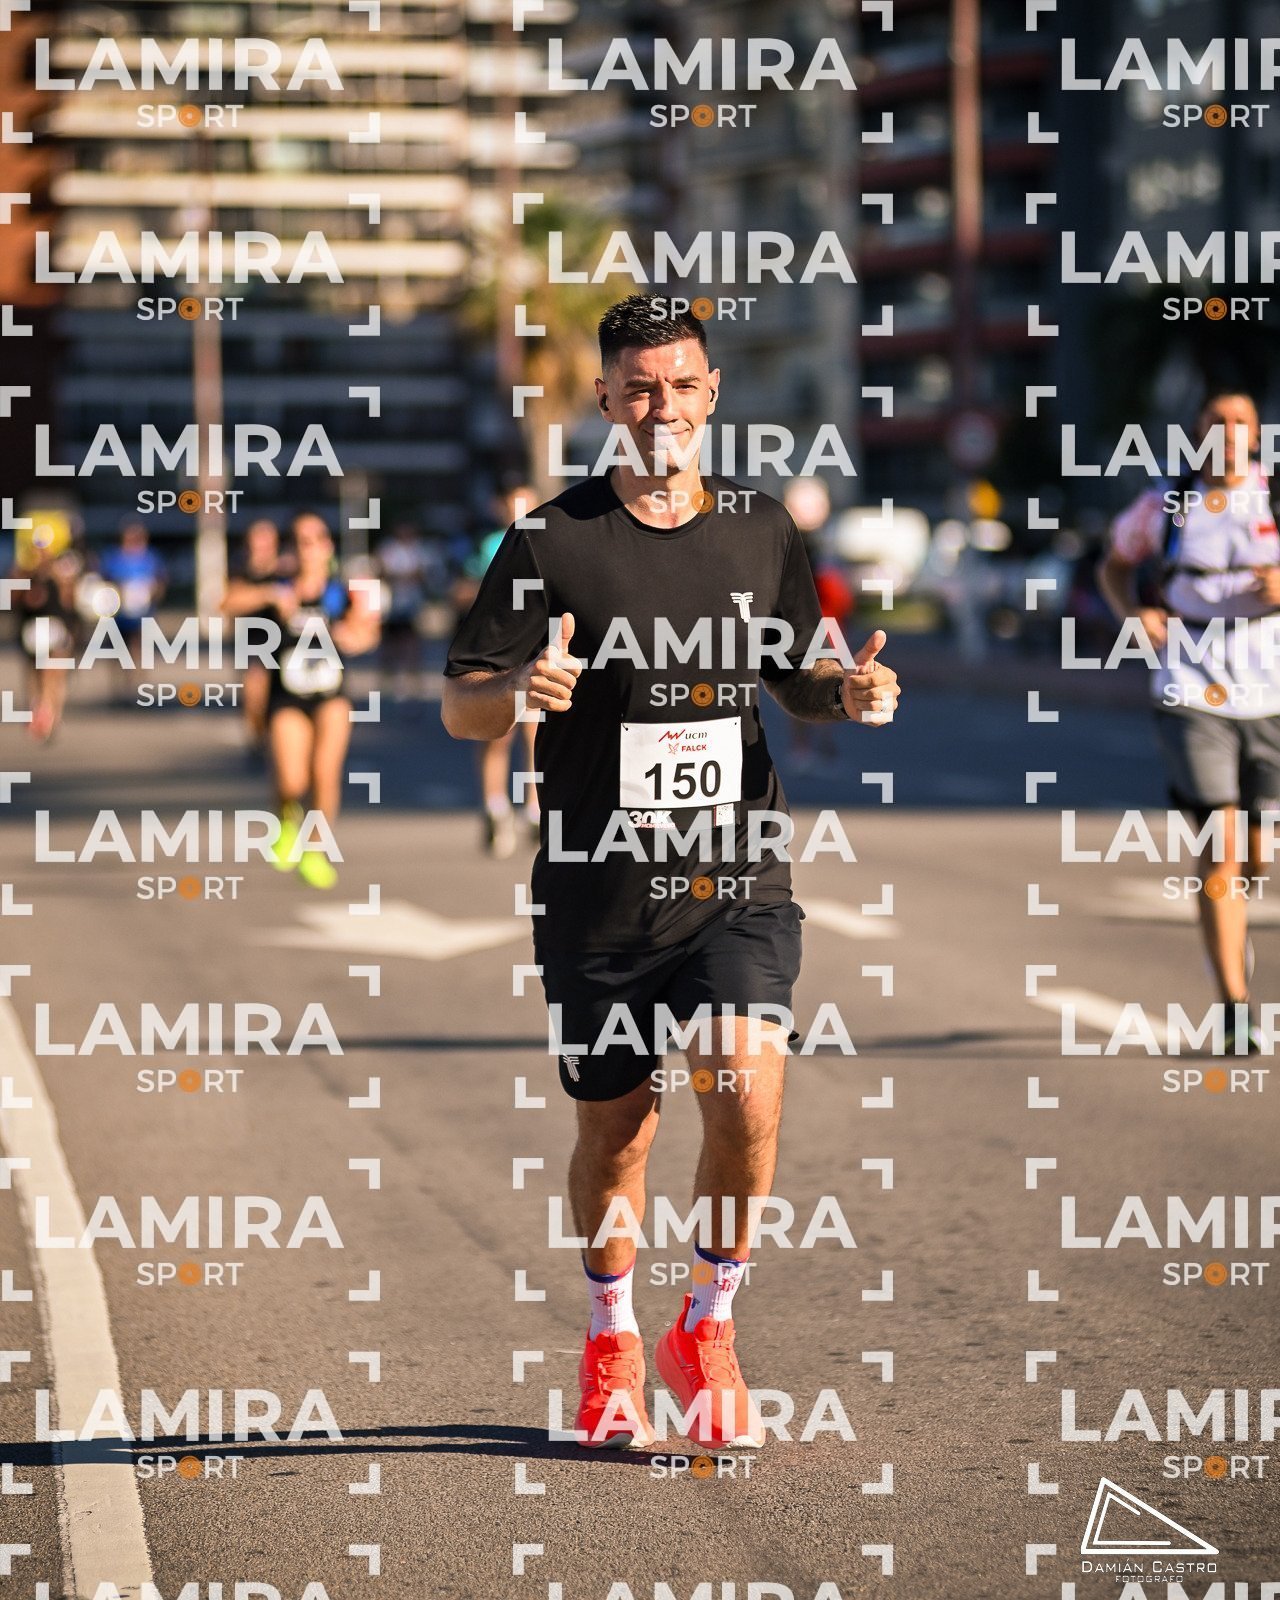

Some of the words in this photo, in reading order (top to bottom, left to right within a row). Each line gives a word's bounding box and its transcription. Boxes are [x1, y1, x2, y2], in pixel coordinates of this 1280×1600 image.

[681, 744, 707, 752] FALCK
[644, 760, 721, 801] 150
[628, 810, 672, 829] 30K
